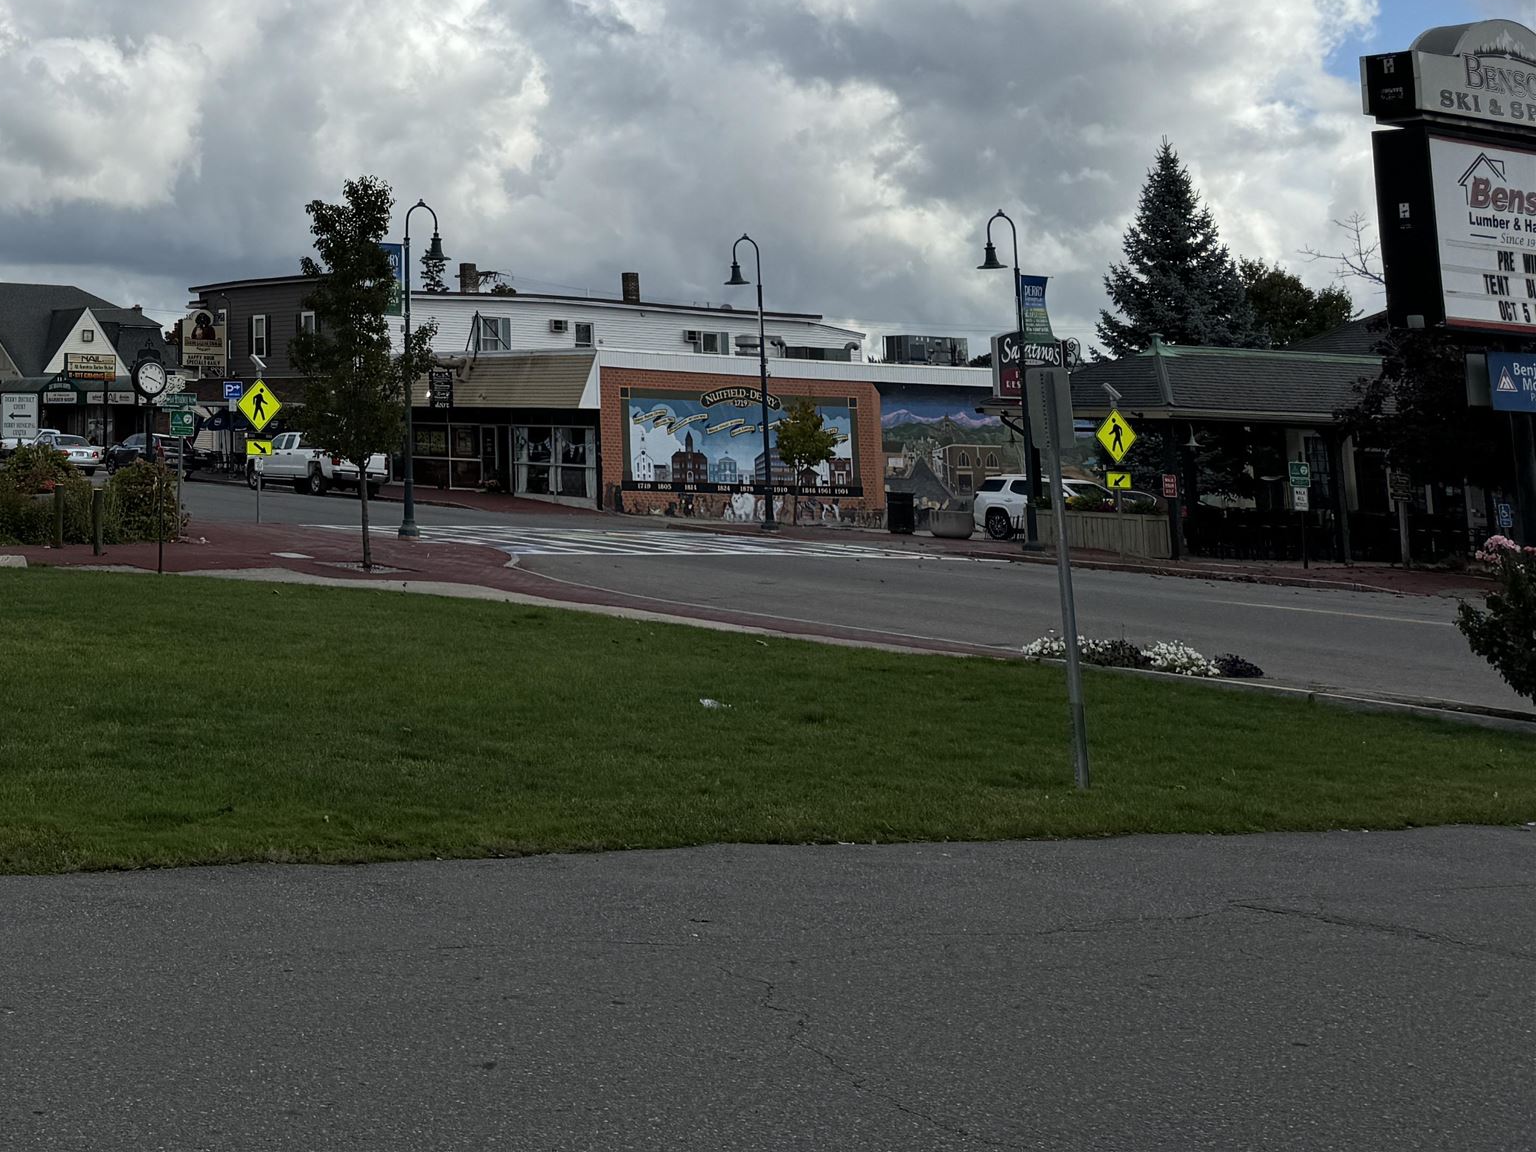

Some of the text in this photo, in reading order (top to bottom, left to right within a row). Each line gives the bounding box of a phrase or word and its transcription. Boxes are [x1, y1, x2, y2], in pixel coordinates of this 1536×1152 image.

[1440, 90, 1481, 112] SKI
[1489, 98, 1504, 116] &
[1469, 212, 1510, 229] Lumber
[1513, 218, 1521, 230] &
[1500, 233, 1524, 246] Since
[1497, 250, 1536, 274] PRE WI
[1483, 274, 1509, 296] TENT
[1499, 300, 1531, 323] OCT 5
